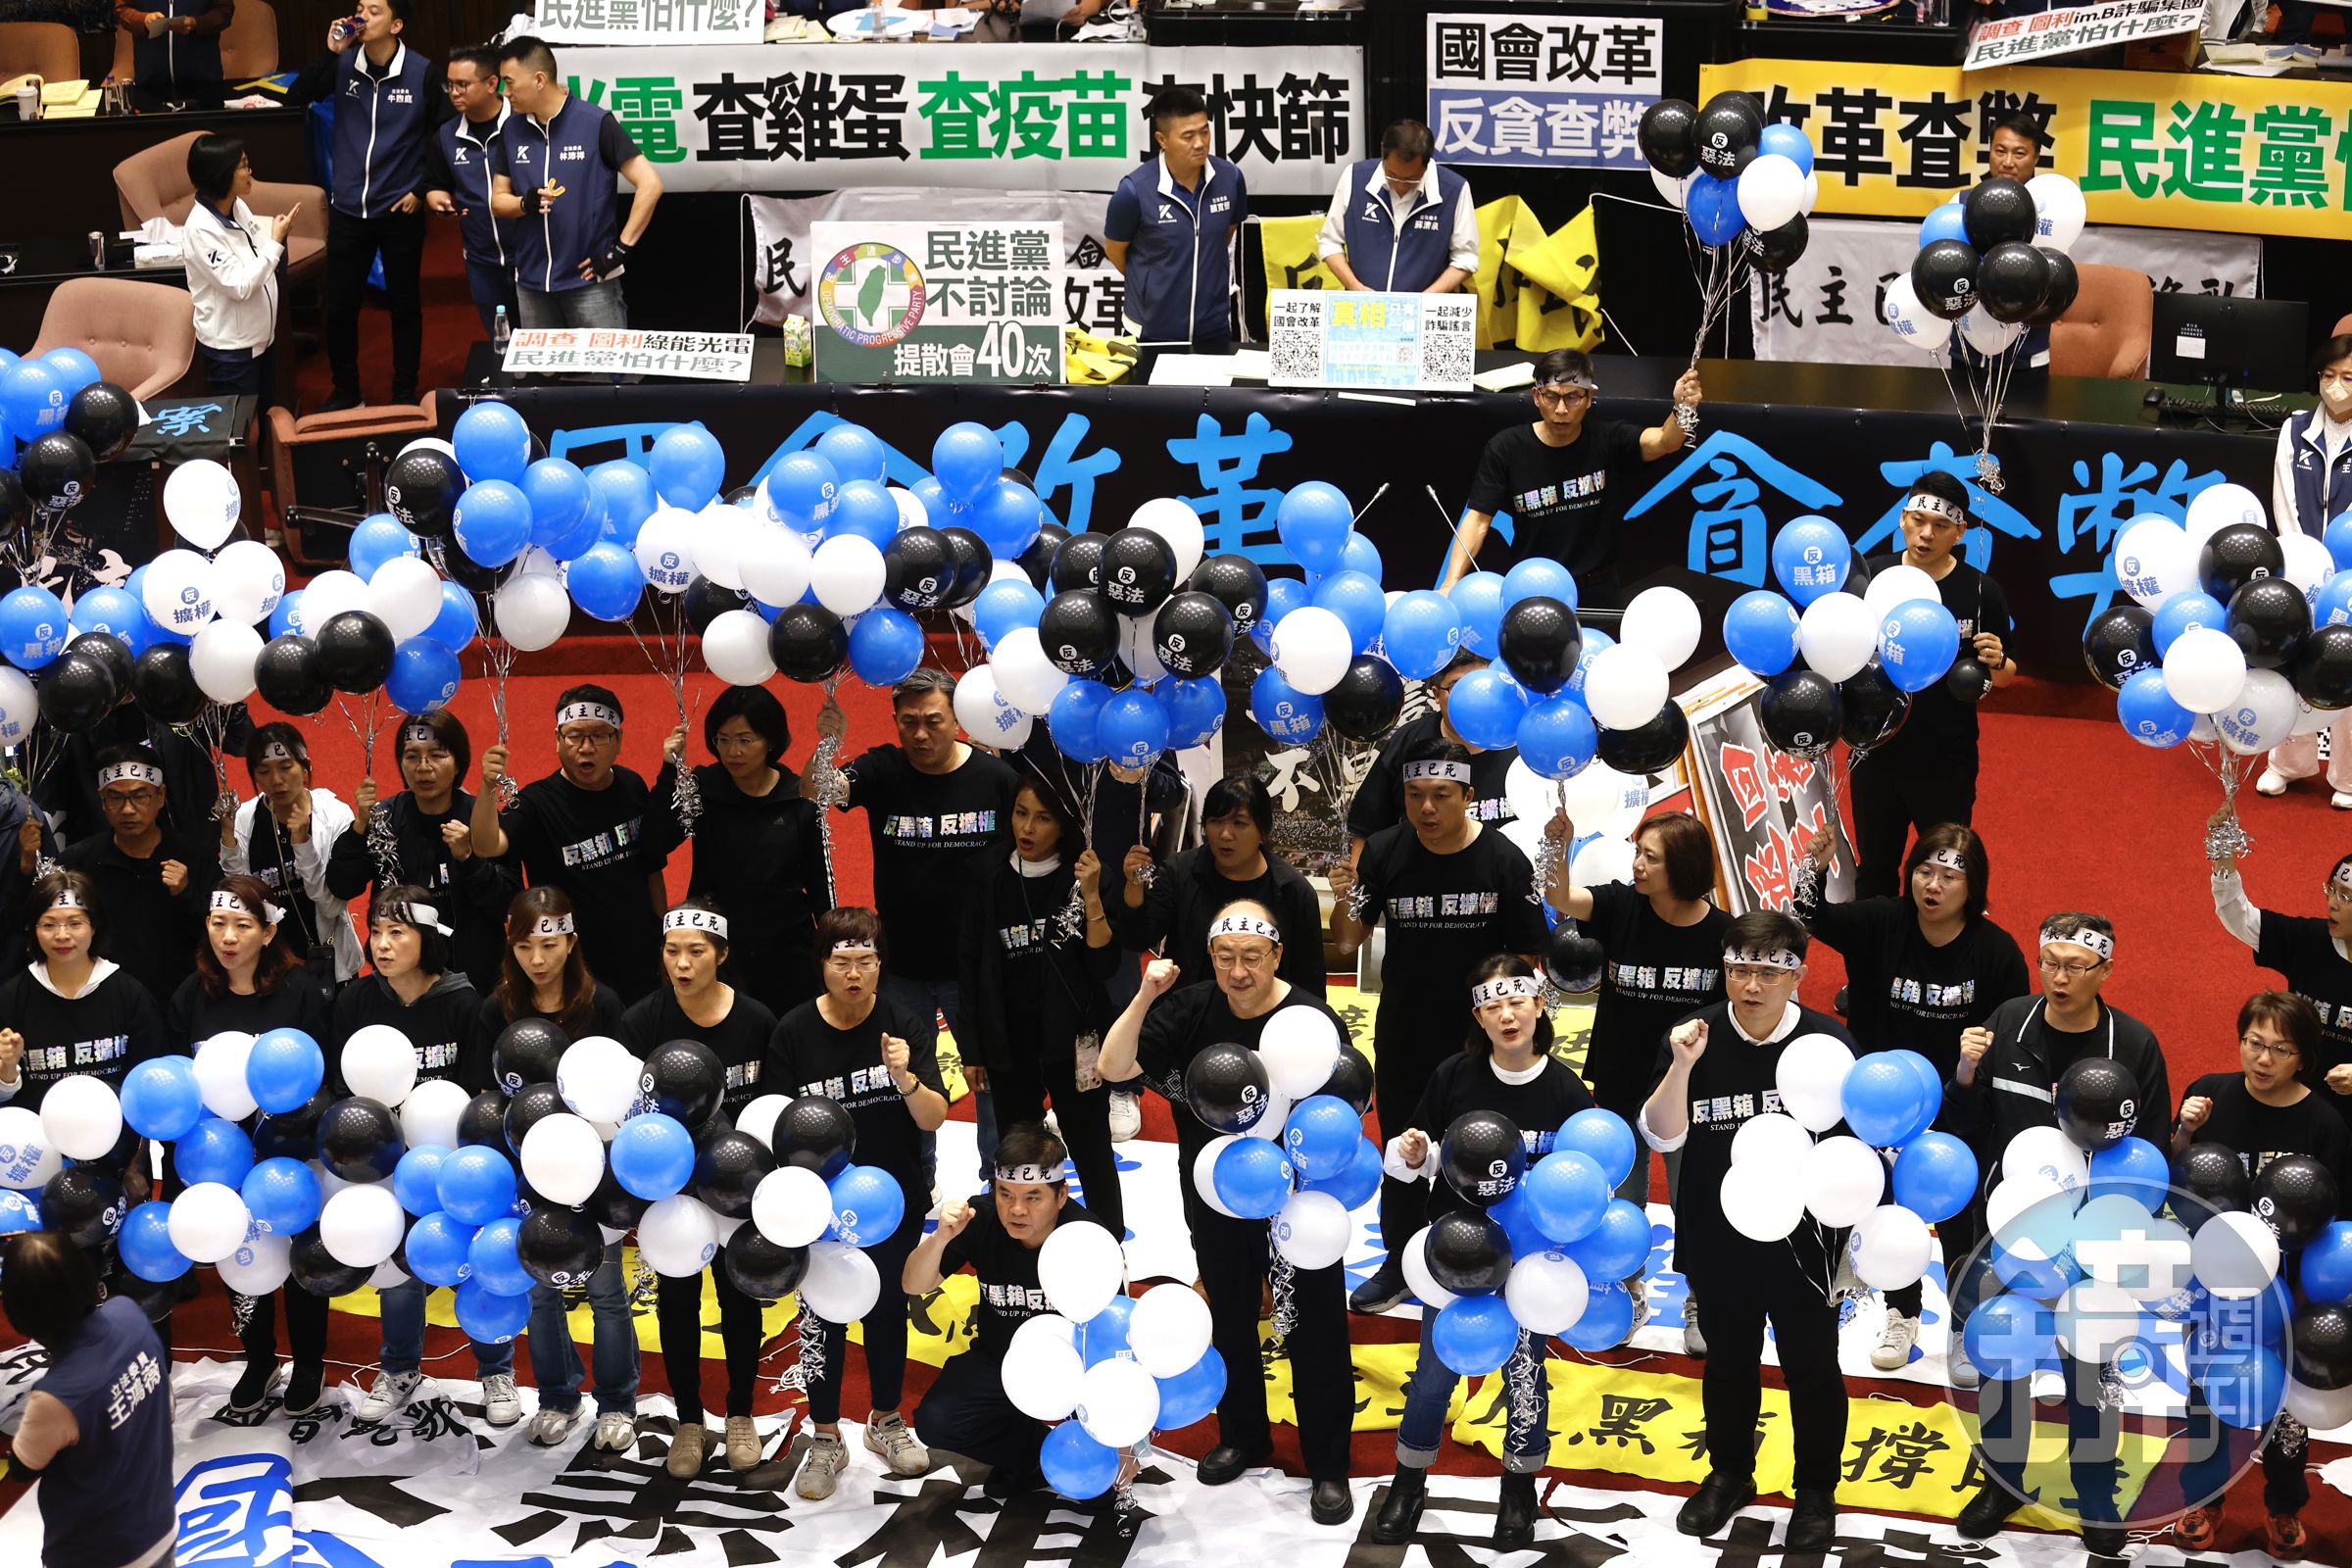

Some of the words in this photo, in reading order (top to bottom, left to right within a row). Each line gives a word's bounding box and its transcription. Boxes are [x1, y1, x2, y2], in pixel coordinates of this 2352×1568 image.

[1971, 14, 2196, 64] 民進黨怕什麼?
[1978, 20, 2024, 42] 調查
[1435, 22, 1656, 85] 國會改革
[693, 71, 910, 162] 查雞蛋
[917, 71, 1132, 161] 查疫苗
[1434, 95, 1648, 161] 反貪查弊
[1712, 132, 1728, 148] 反
[1700, 145, 1736, 168] 惡法
[924, 229, 1051, 271] 民進黨
[1954, 278, 1969, 293] 反
[925, 276, 1053, 318] 不討論
[1274, 302, 1321, 314] 一起了解
[1332, 301, 1387, 328] 真相
[1425, 306, 1473, 318] 一起減少
[1274, 316, 1321, 327] 國會改革
[514, 332, 577, 348] 調查
[589, 332, 753, 356] 圖利綠能光電
[894, 320, 1053, 378] 提散會40次
[509, 350, 744, 374] 民進黨怕什麼?
[1917, 496, 1963, 524] 民主已死
[662, 553, 678, 568] 反
[1805, 547, 1821, 563] 反
[1118, 566, 1135, 583] 反
[1793, 564, 1837, 586] 黑箱
[2125, 558, 2139, 574] 反
[919, 578, 936, 592] 反
[1107, 580, 1145, 604] 惡法
[182, 587, 198, 604] 反
[173, 601, 212, 624] 擴權
[1236, 603, 1251, 618] 反
[36, 624, 51, 640] 反
[1886, 620, 1900, 636] 反
[1169, 635, 1184, 651] 反
[1059, 645, 1076, 660] 反
[1157, 644, 1193, 672] 惡法
[2119, 650, 2134, 666] 反
[564, 704, 617, 724] 民主已死
[1276, 703, 1293, 718] 反
[2238, 709, 2256, 725] 反
[1269, 714, 1311, 735] 黑箱
[2221, 714, 2261, 747] 擴權
[1133, 741, 1149, 755] 反
[101, 764, 155, 782] 民主已死
[1403, 761, 1456, 778] 民主已死
[562, 831, 613, 866] 反黑箱
[540, 916, 567, 934] 已死
[663, 911, 720, 931] 民主已死
[1734, 948, 1793, 966] 民主已死
[1473, 979, 1525, 1004] 民主已死
[23, 1045, 67, 1071] 黑箱
[851, 1064, 899, 1096] 反擴
[1243, 1086, 1256, 1102] 反
[1236, 1094, 1269, 1125] 惡法
[1692, 1093, 1754, 1125] 反黑箱
[1761, 1089, 1788, 1114] 反
[2121, 1100, 2133, 1117] 反
[1710, 1123, 1736, 1132] STAND
[1290, 1129, 1302, 1145] 反
[996, 1165, 1052, 1181] 民主已死
[1490, 1160, 1507, 1176] 反
[1477, 1176, 1516, 1197] 惡法
[2260, 1199, 2274, 1215] 反
[841, 1209, 857, 1226] 反
[109, 1350, 150, 1399] 立法委員
[107, 1355, 163, 1431] 王鴻薇
